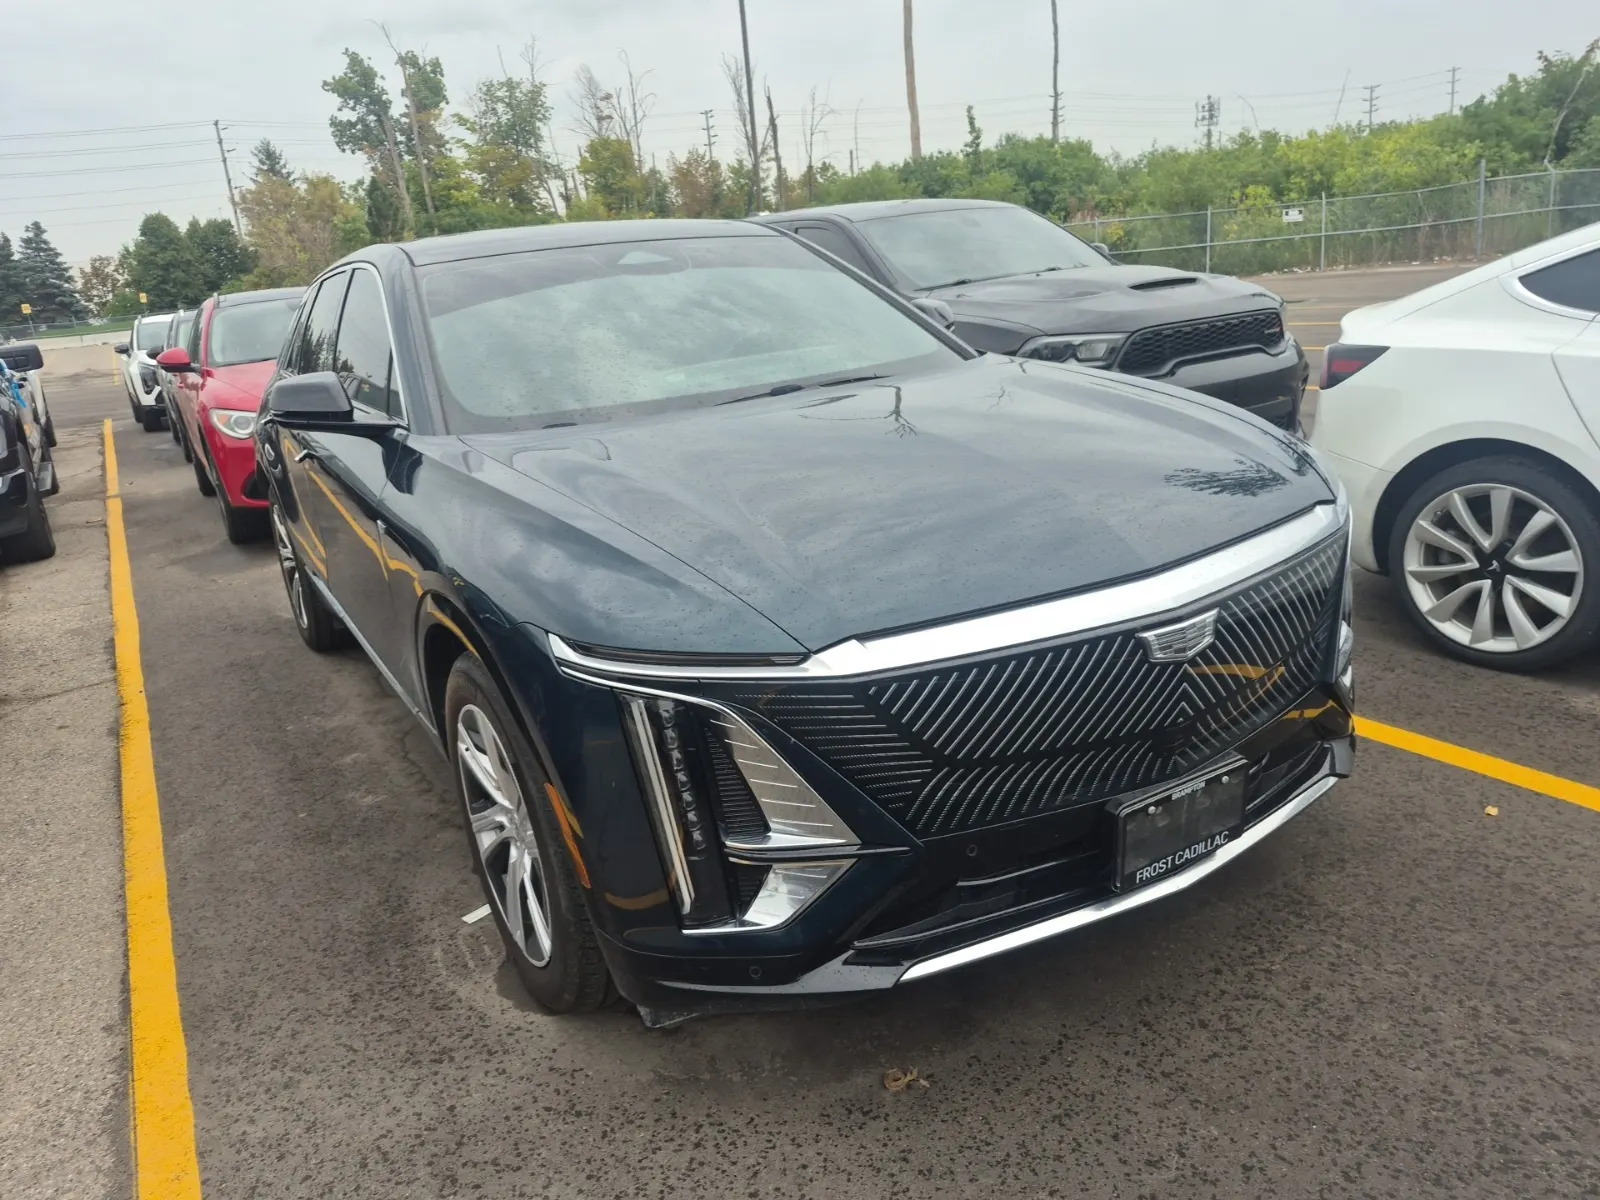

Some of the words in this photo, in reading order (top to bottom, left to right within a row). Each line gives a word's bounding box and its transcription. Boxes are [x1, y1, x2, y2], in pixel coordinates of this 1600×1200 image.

[1171, 781, 1206, 801] BRAMPTON
[1136, 855, 1174, 884] FROST
[1175, 831, 1229, 865] CADILLAC
